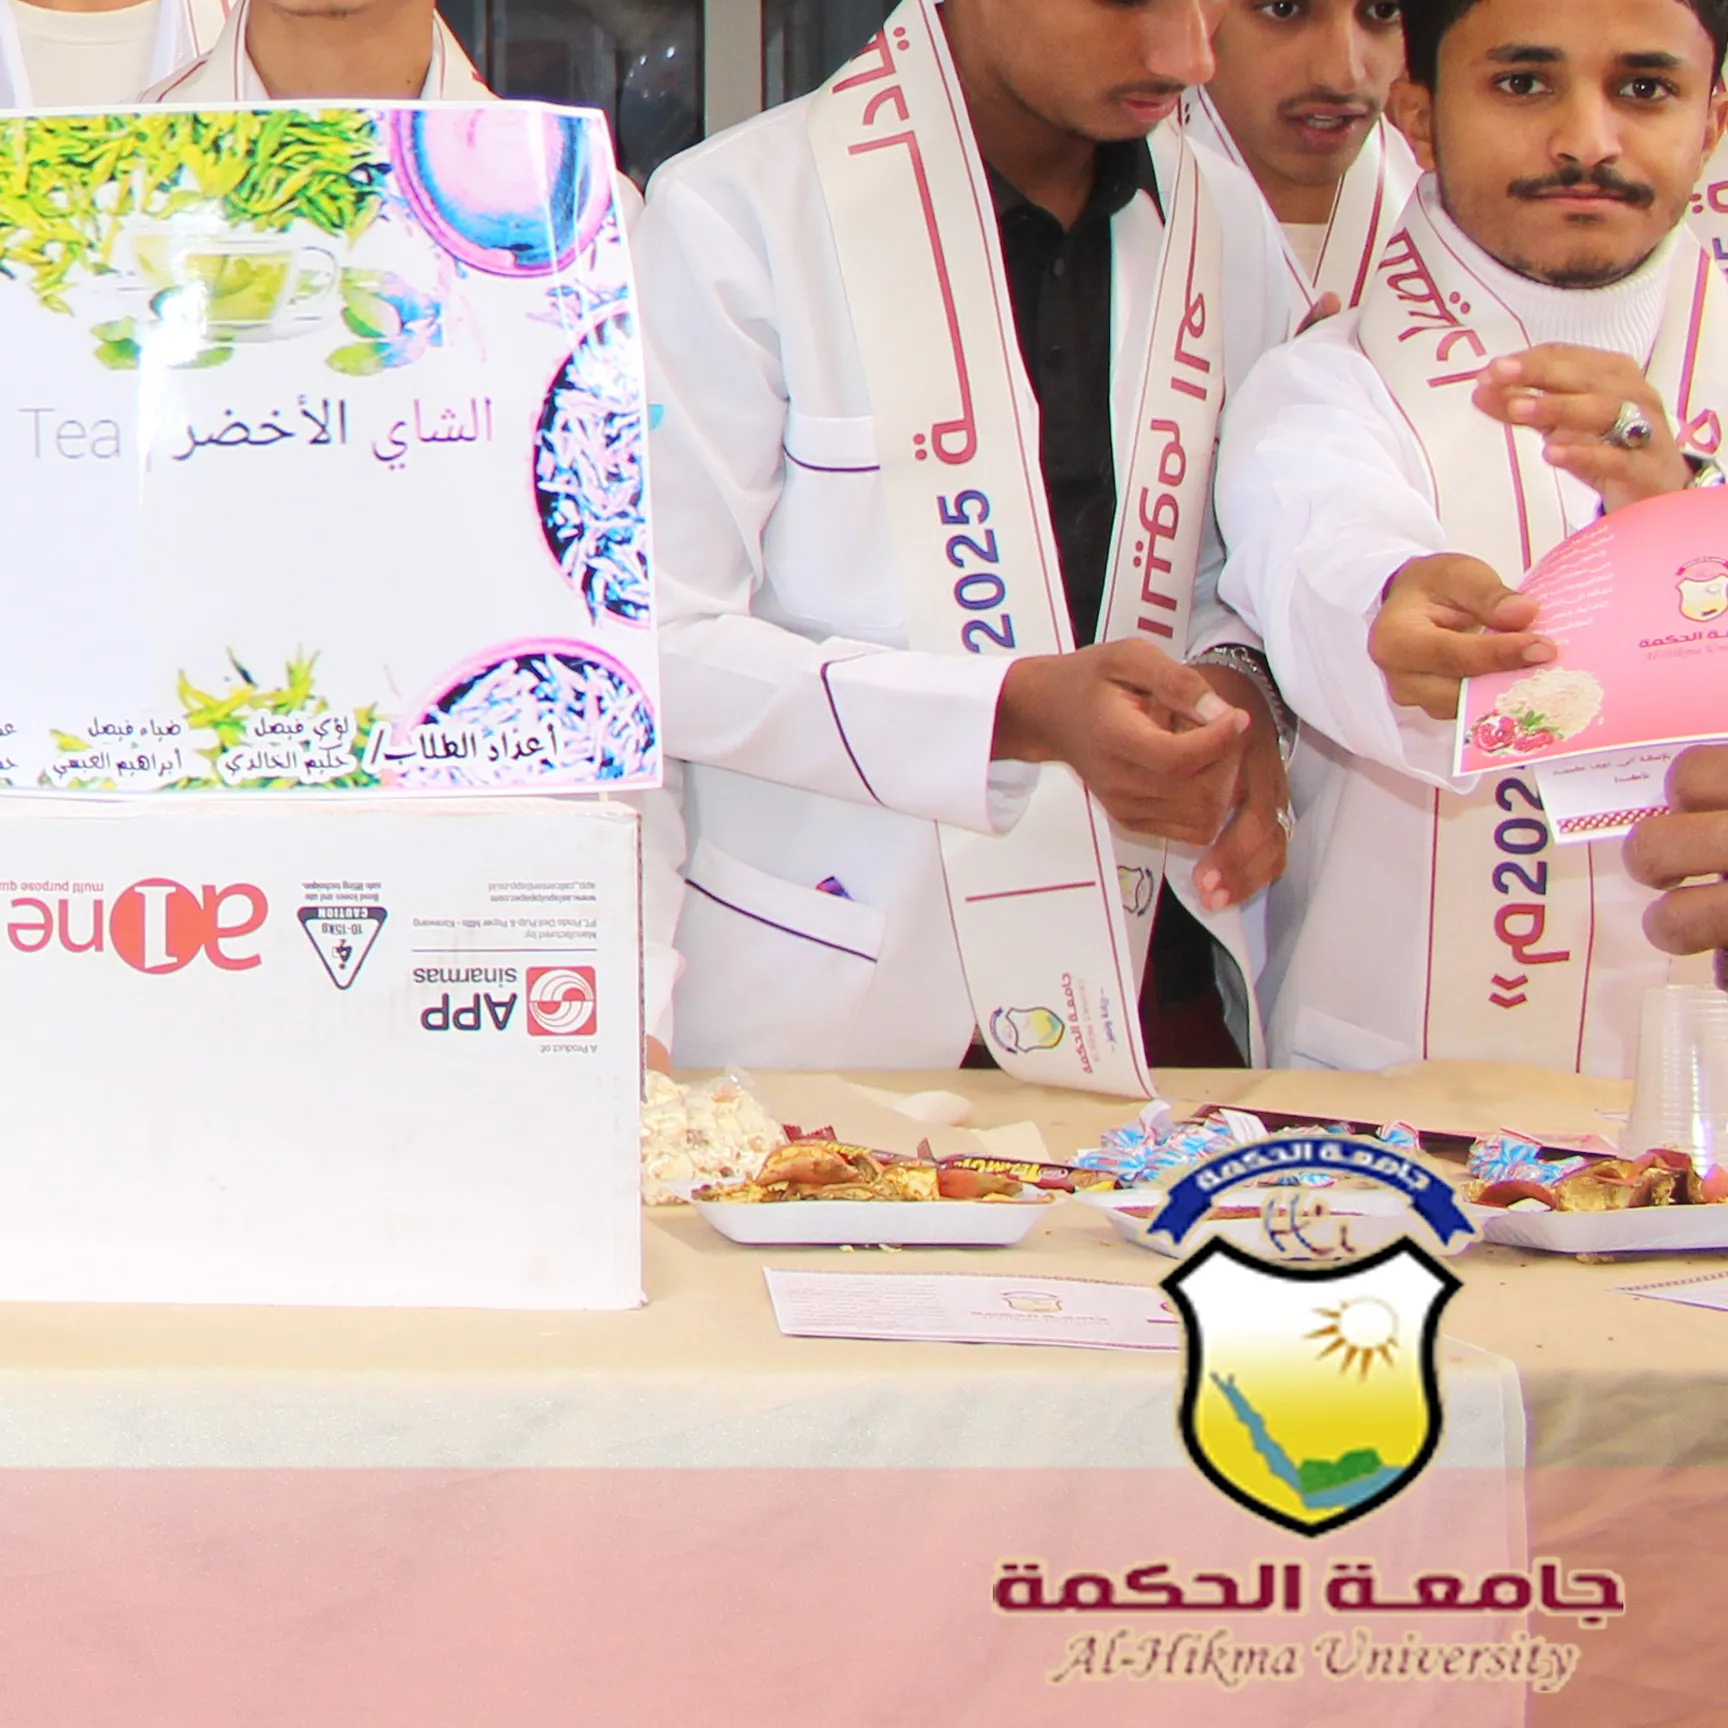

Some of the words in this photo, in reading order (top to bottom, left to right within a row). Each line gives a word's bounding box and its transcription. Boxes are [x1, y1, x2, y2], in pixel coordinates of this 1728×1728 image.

[18, 406, 122, 459] Tea
[171, 392, 350, 461] الأخضر
[371, 396, 494, 470] الشاي
[88, 717, 135, 743] فيصل
[254, 715, 304, 737] فيصل
[224, 748, 298, 777] الخالدي
[305, 743, 349, 775] حكيم
[20, 880, 70, 894] purpose
[72, 880, 104, 893] multi
[317, 907, 369, 919] CAUTION
[321, 923, 363, 936] 10-15kg
[412, 967, 518, 988] sinarmas
[420, 991, 519, 1031] APP
[553, 1044, 588, 1054] Product
